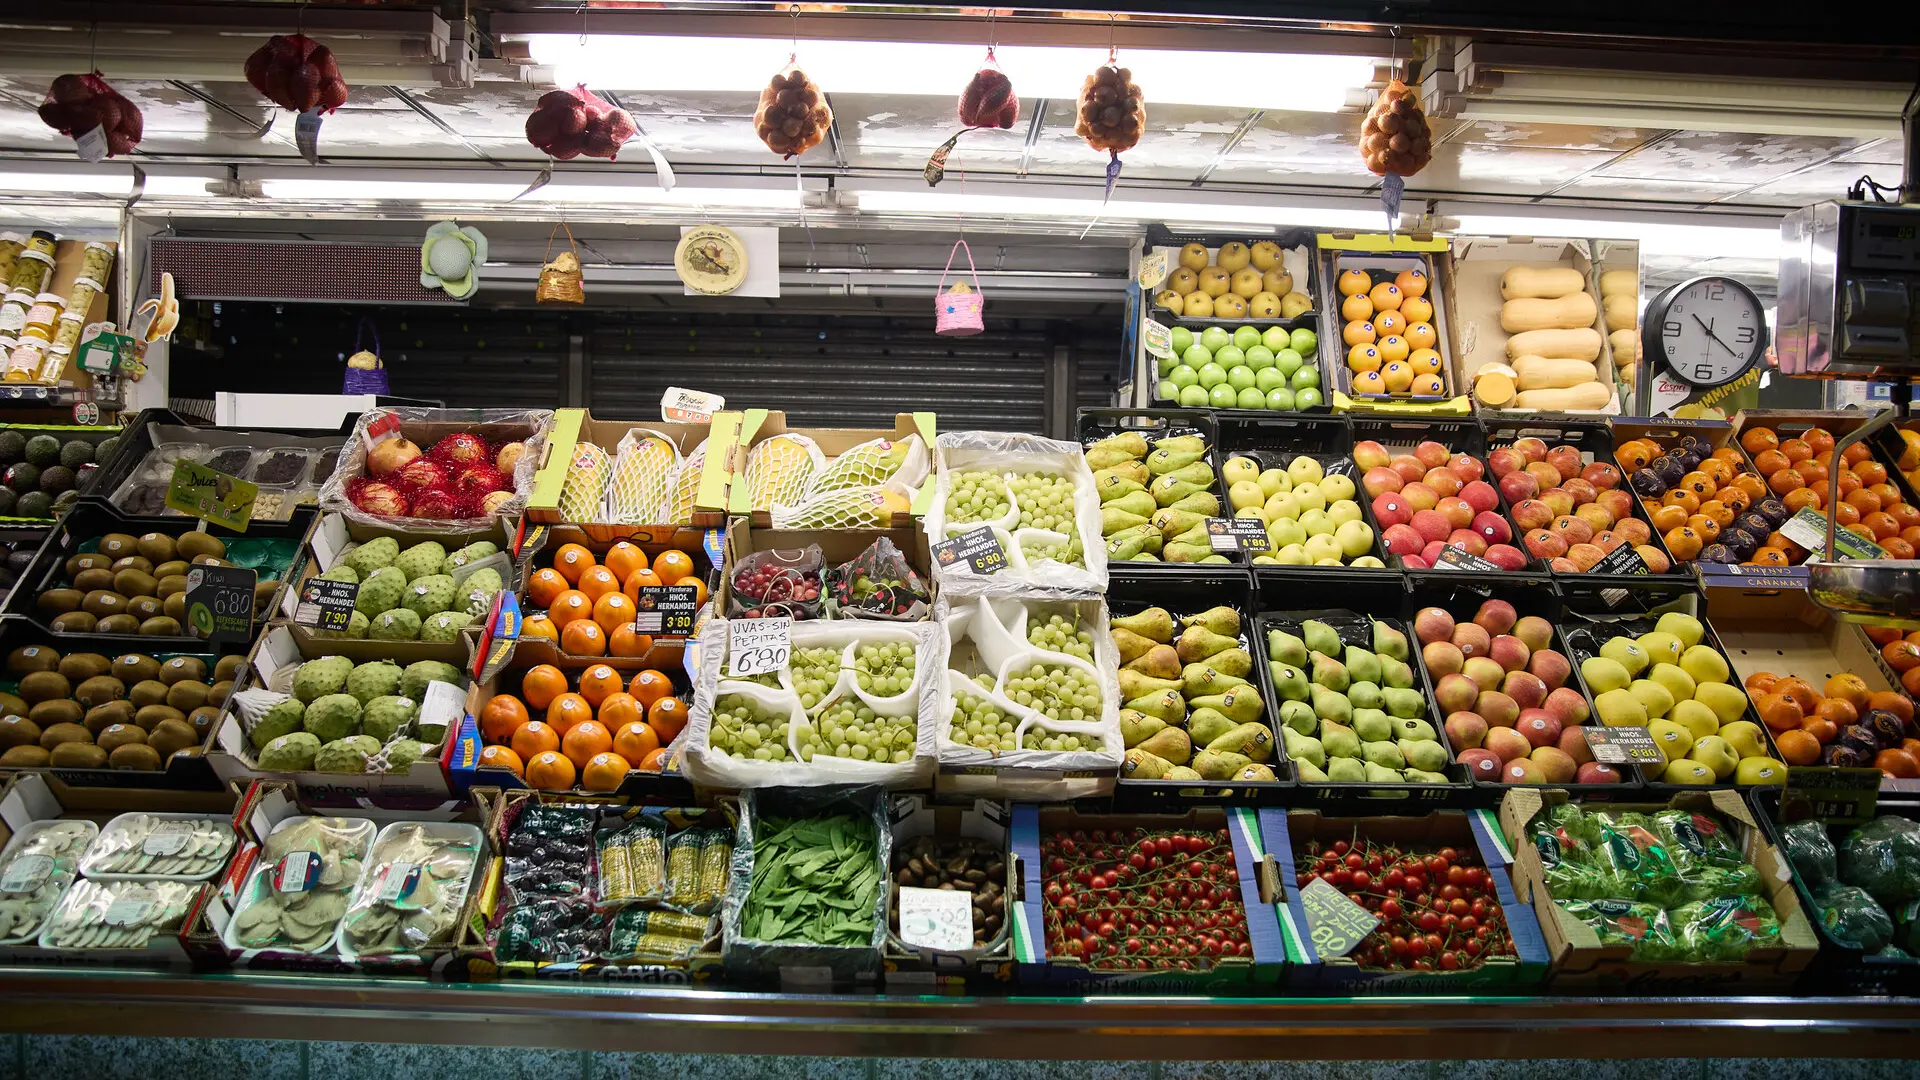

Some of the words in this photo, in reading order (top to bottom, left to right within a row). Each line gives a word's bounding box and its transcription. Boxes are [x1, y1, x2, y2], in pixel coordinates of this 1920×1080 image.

[1690, 290, 1697, 299] 11
[1704, 285, 1726, 301] 12
[1673, 304, 1683, 313] 10
[1742, 310, 1750, 319] 2
[1663, 321, 1682, 338] 9
[1735, 326, 1755, 344] 3
[1667, 346, 1675, 355] 8
[1737, 352, 1744, 360] 4
[1680, 362, 1688, 371] 7
[1694, 363, 1713, 380] 6
[1720, 366, 1727, 375] 5
[958, 539, 998, 558] HERNANDEZ
[976, 552, 1001, 569] 6'80
[215, 590, 250, 614] 6'80
[318, 596, 354, 607] HERNANDEZ
[657, 602, 696, 610] HERNANDEZ
[325, 611, 347, 625] 7'90
[667, 616, 691, 628] 3'80
[732, 631, 787, 647] PEPITAS
[737, 648, 787, 672] 6'80
[1629, 748, 1657, 758] 3'80
[1312, 884, 1378, 930] CHERRIS
